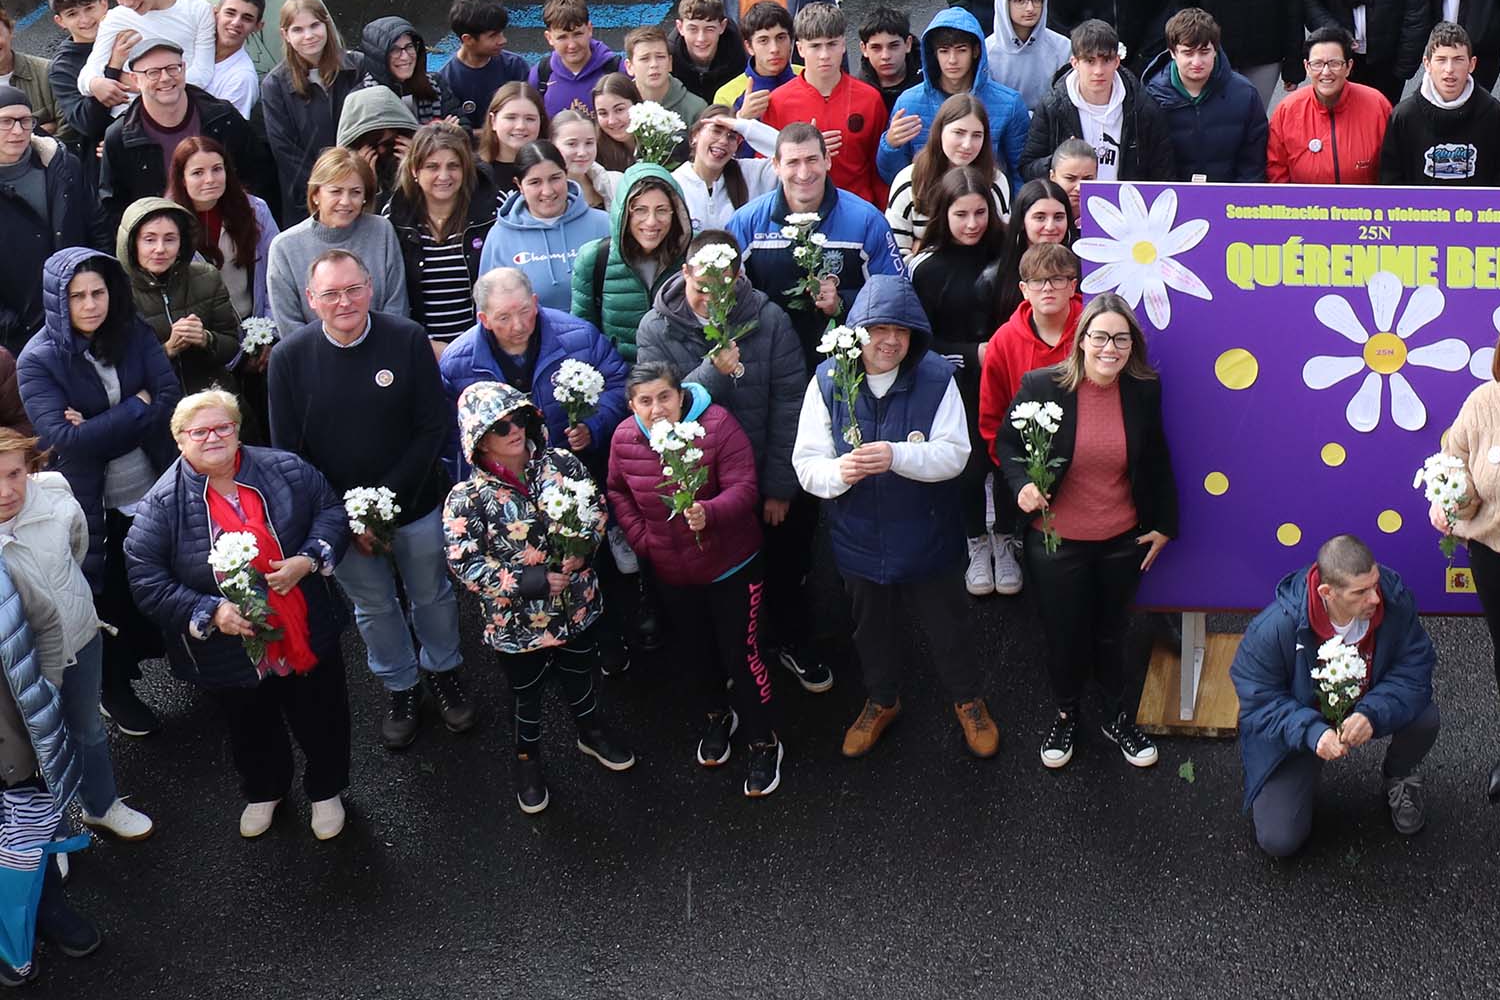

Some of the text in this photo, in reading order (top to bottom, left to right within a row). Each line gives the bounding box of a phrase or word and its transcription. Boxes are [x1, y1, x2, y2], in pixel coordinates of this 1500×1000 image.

[1226, 204, 1329, 220] Sensibilización
[1331, 206, 1372, 221] frente
[1374, 209, 1383, 221] a
[1388, 207, 1450, 222] violencia
[1455, 208, 1473, 223] de
[1358, 226, 1392, 240] 25N
[1226, 236, 1439, 290] QUÉRENME
